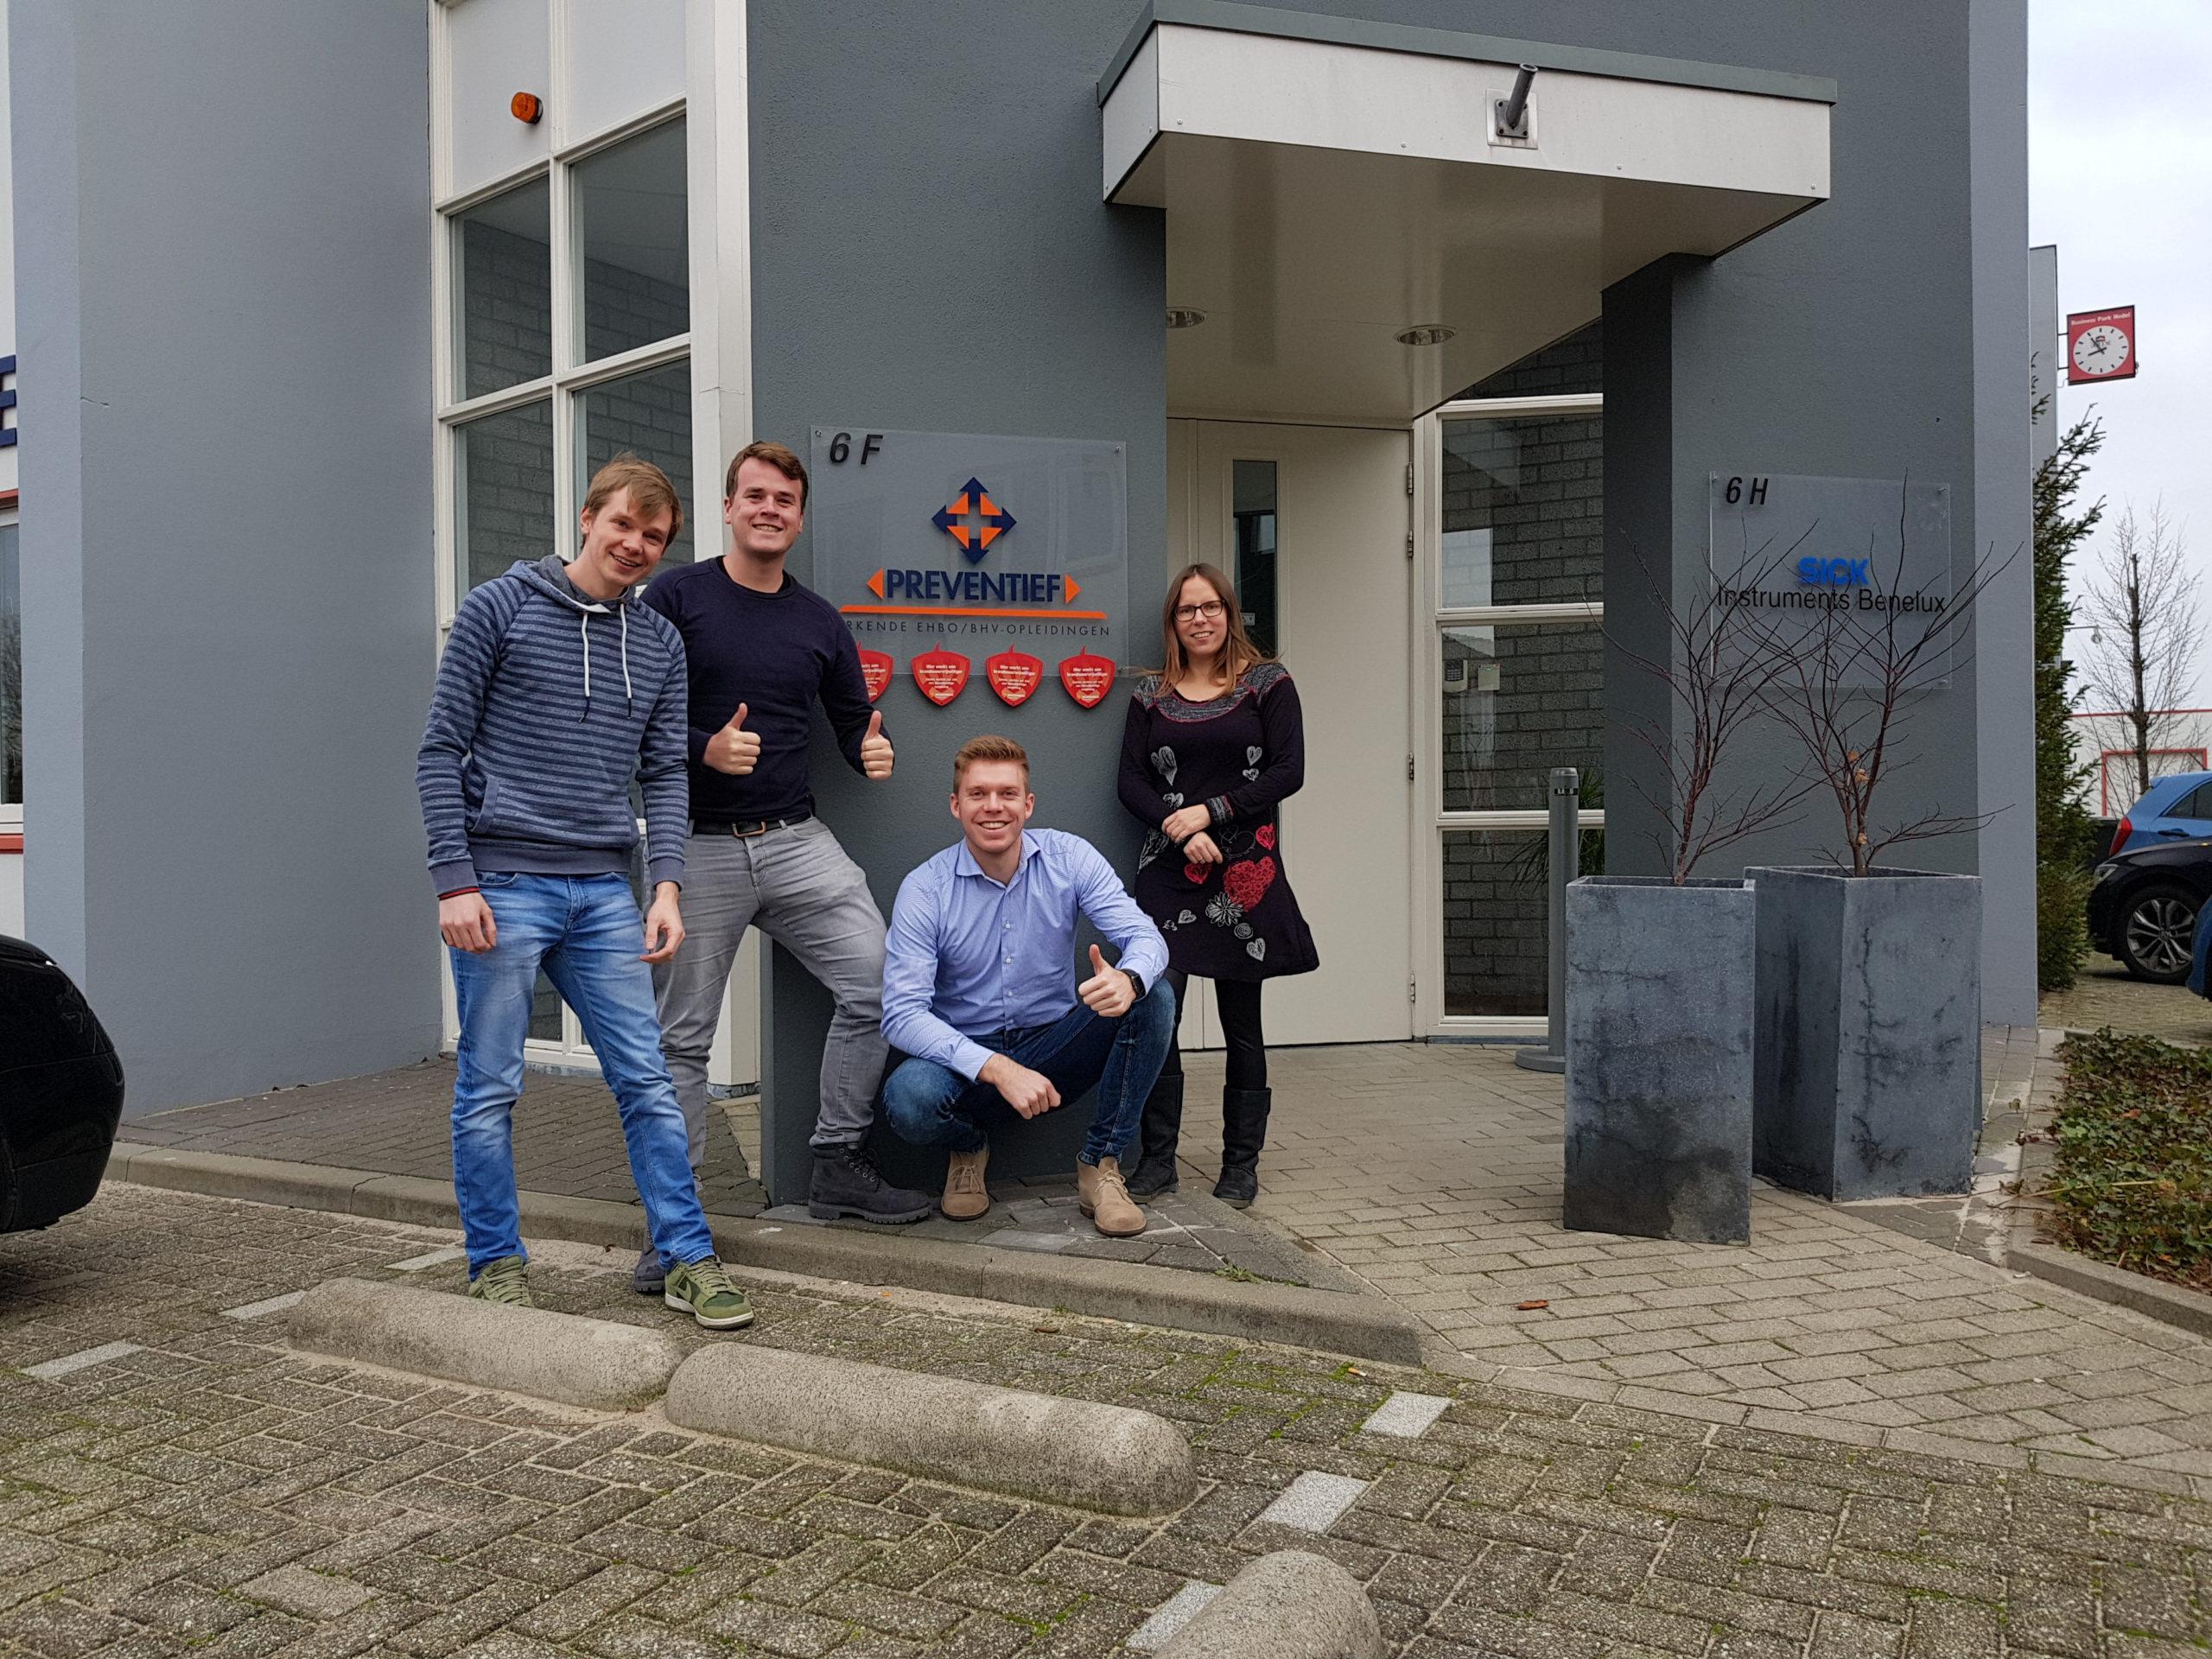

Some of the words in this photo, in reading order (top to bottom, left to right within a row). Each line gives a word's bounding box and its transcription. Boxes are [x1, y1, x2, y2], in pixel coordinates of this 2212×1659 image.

[830, 432, 851, 464] 6
[861, 434, 883, 465] F
[1726, 476, 1743, 504] 6
[1750, 477, 1768, 505] H
[1797, 556, 1869, 585] SICK
[886, 569, 1062, 602] PREVENTIEF
[1718, 585, 1850, 610] Instruments
[1859, 588, 1946, 613] Benelux
[847, 620, 906, 632] RKENDE
